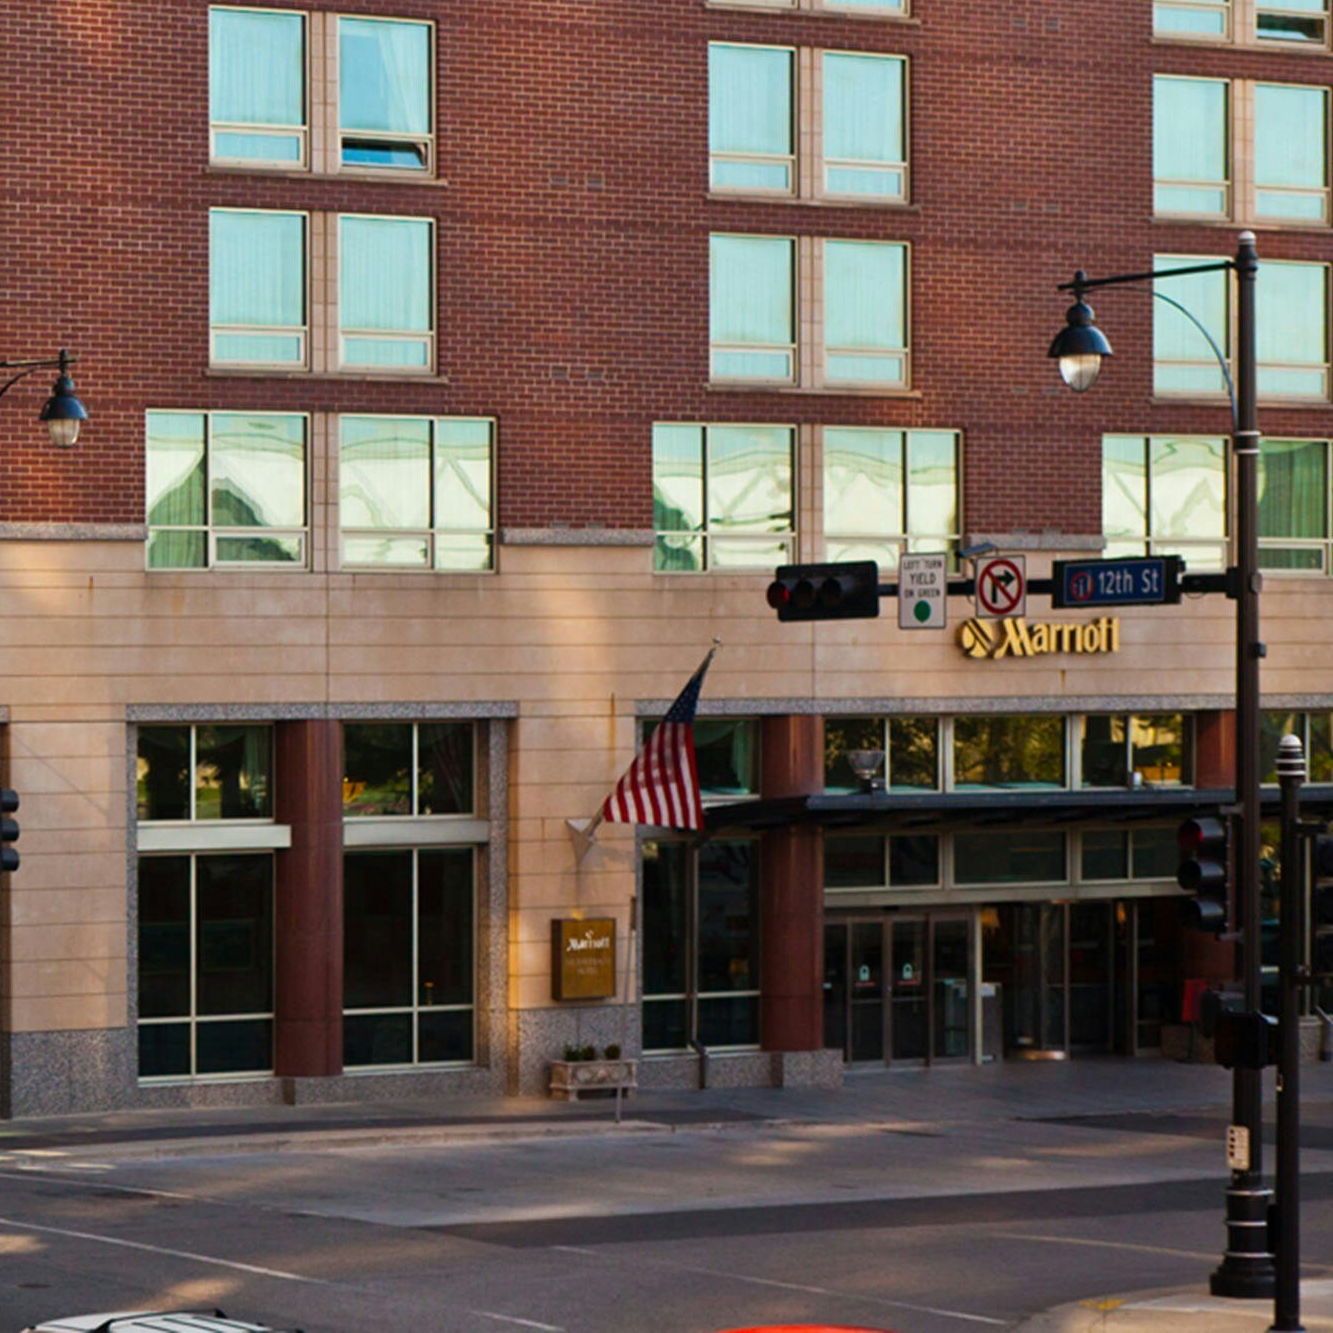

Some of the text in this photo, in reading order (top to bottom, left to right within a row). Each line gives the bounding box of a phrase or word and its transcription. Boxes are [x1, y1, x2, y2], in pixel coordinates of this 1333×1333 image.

[924, 558, 942, 569] TURN
[909, 572, 937, 585] YIELD
[1098, 568, 1159, 595] 12th St
[917, 587, 941, 598] GREEN
[994, 616, 1120, 659] Marriott
[566, 936, 610, 952] Marriott
